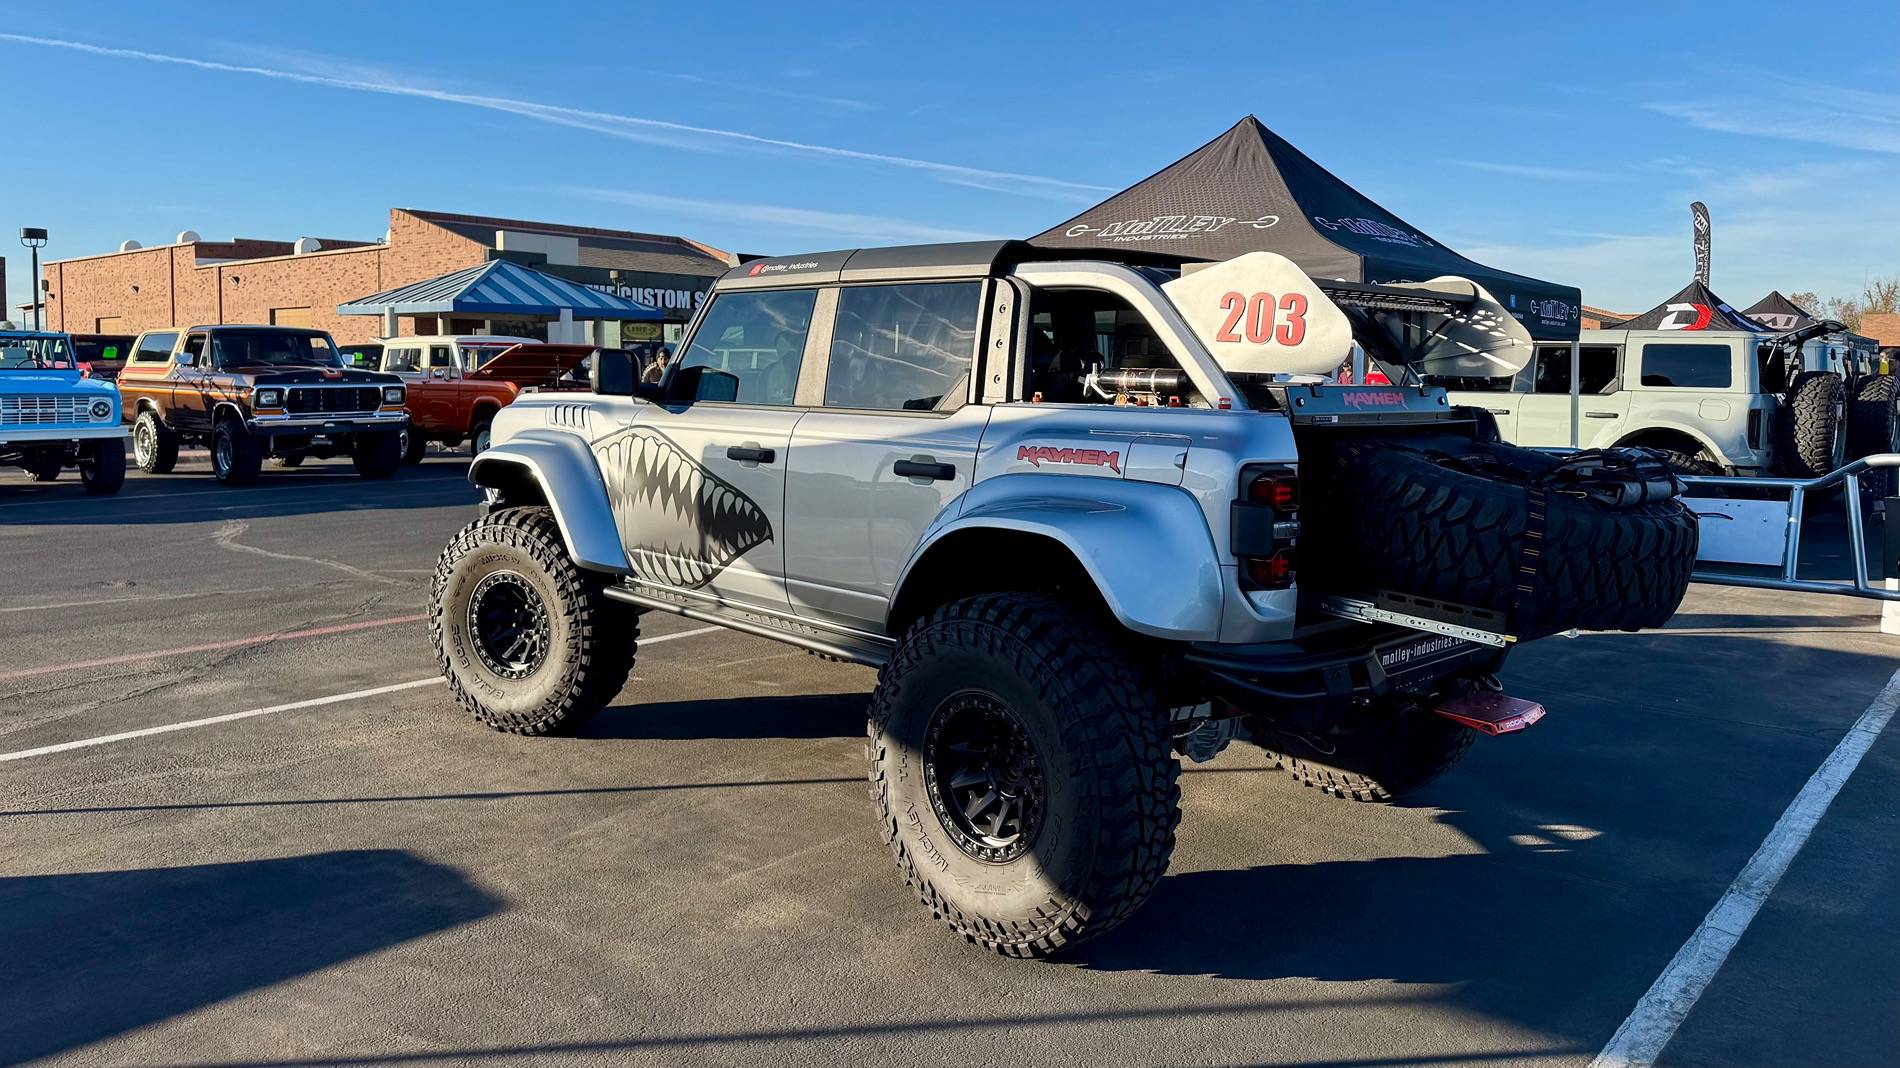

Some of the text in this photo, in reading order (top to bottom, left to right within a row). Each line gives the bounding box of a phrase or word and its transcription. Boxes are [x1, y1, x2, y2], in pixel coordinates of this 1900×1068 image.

[1113, 233, 1188, 243] INDUSTRIES
[620, 286, 691, 309] CUSTOM
[1216, 291, 1309, 347] 203
[1342, 391, 1409, 411] MAYHEM
[1017, 445, 1121, 474] MAYHEM
[450, 623, 471, 670] BOSS
[1382, 636, 1468, 666] motley-industries.co
[906, 801, 949, 873] MICKEY
